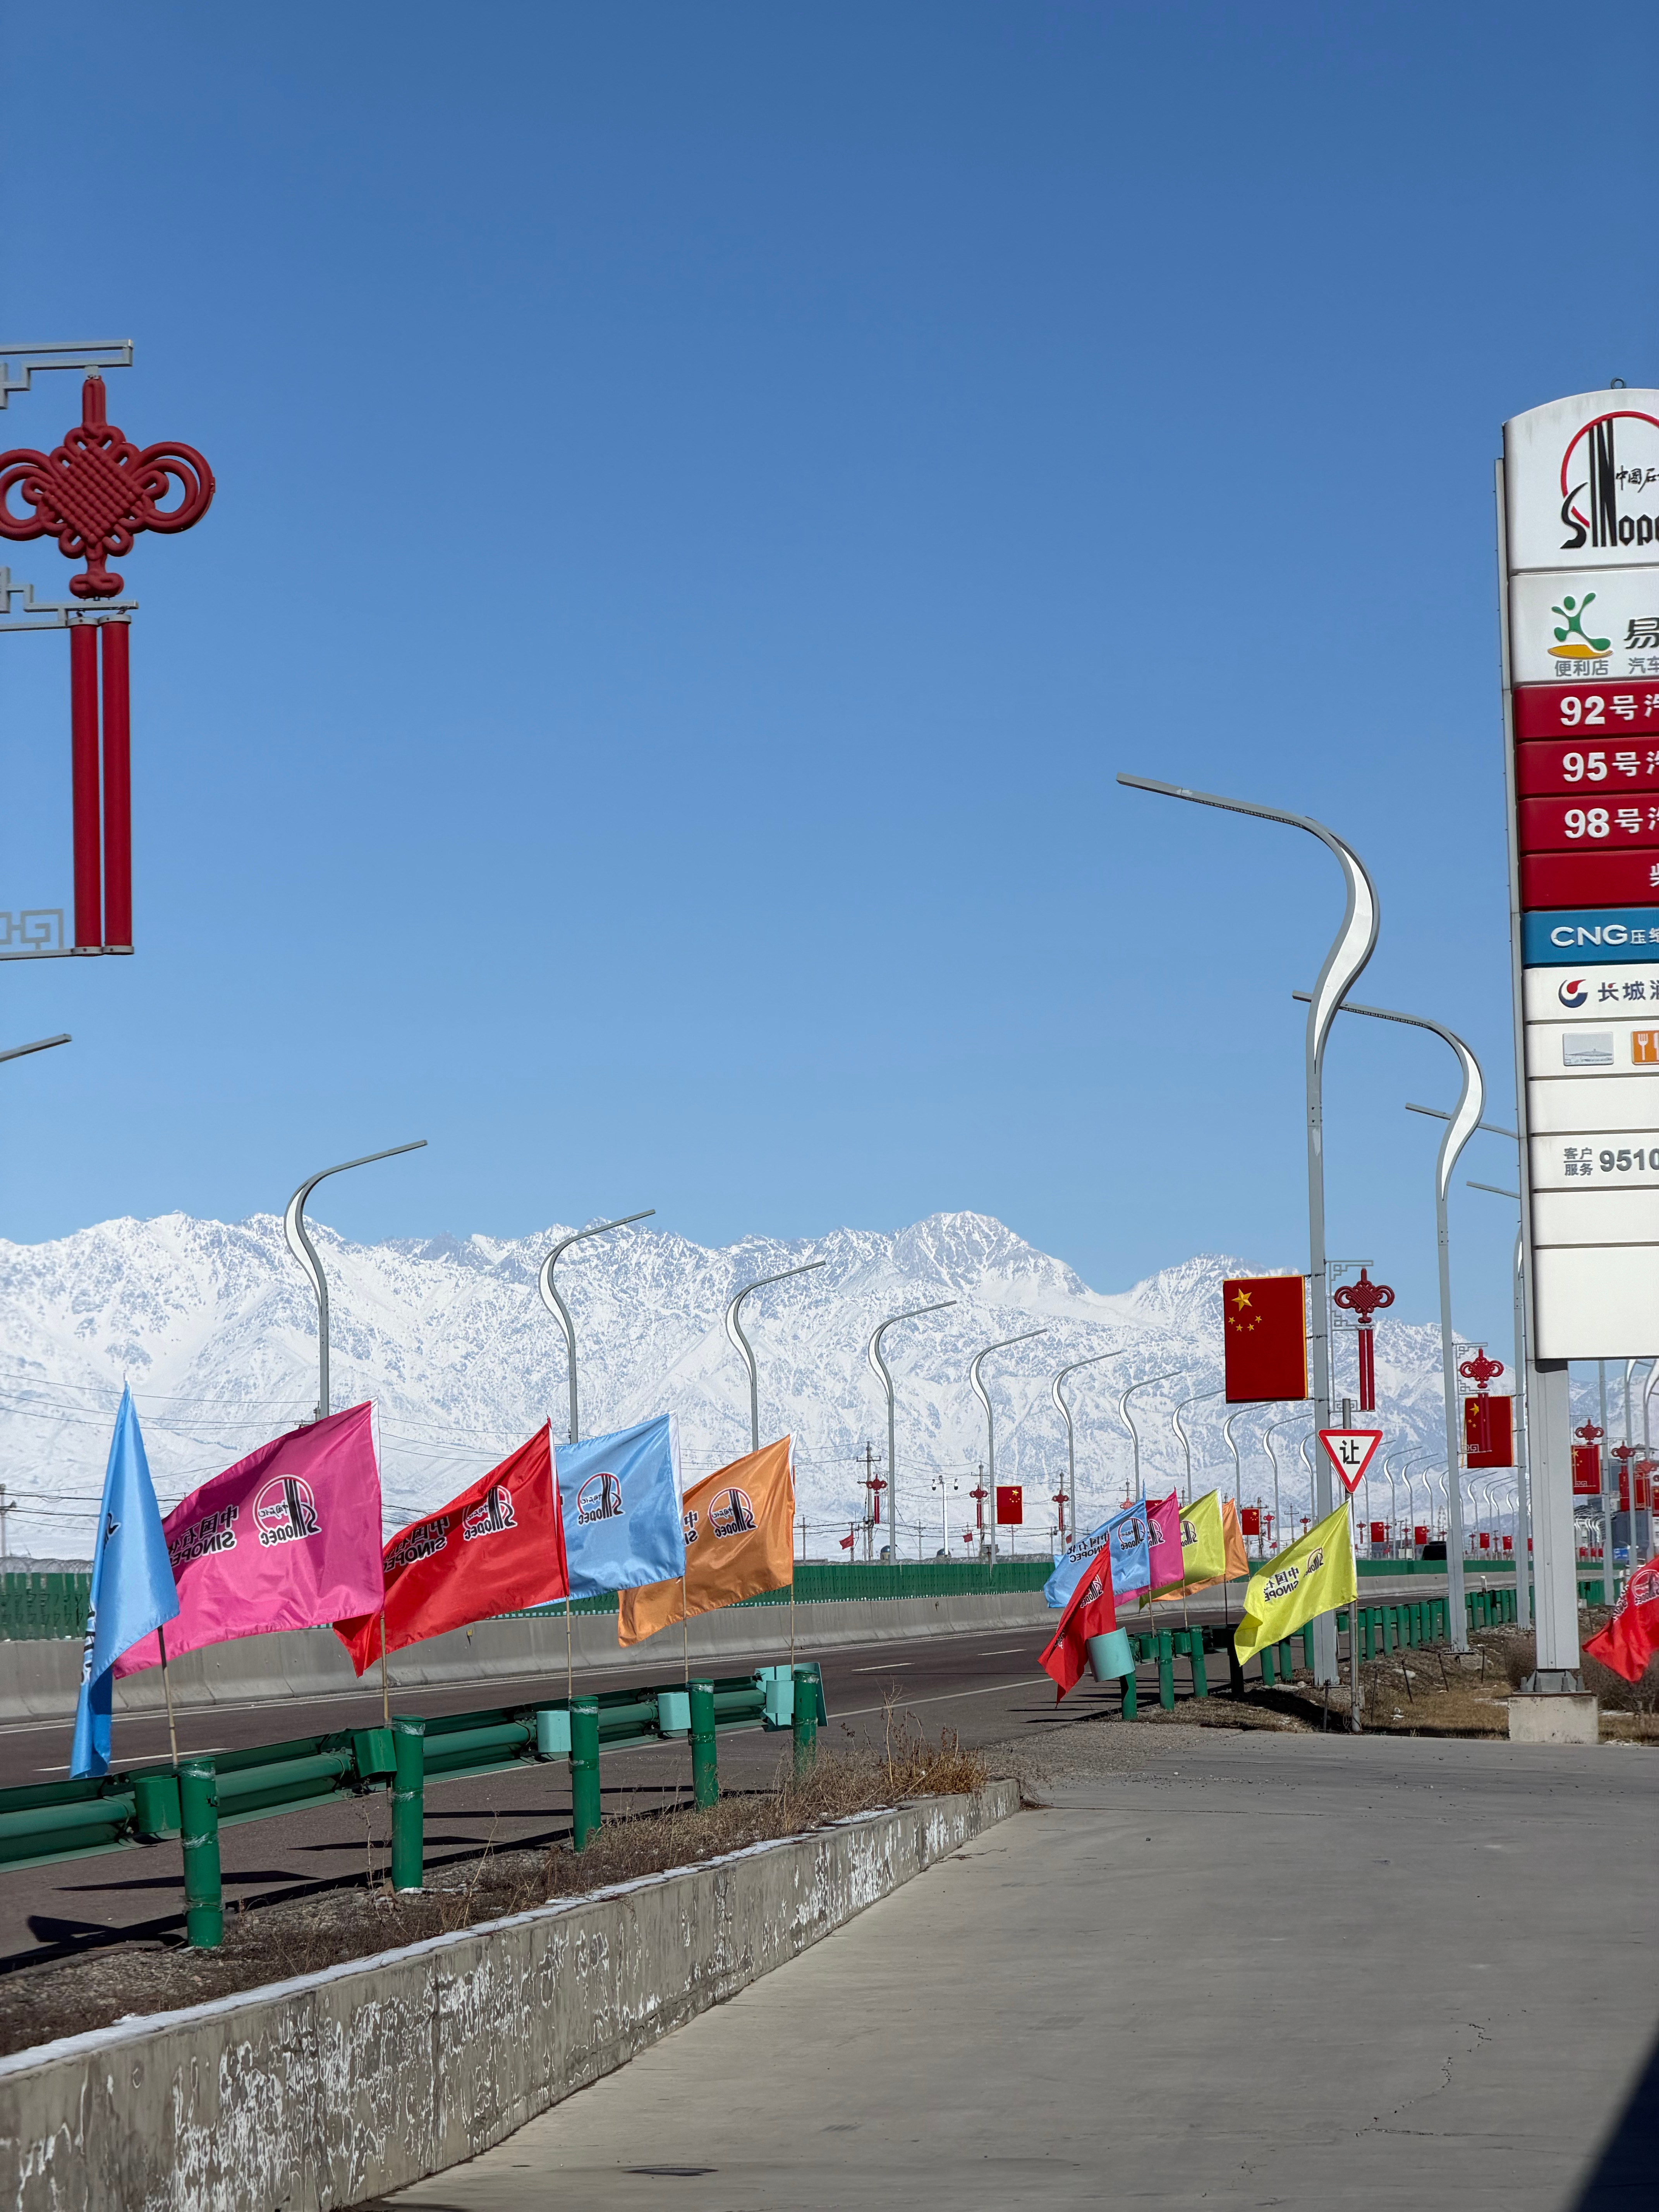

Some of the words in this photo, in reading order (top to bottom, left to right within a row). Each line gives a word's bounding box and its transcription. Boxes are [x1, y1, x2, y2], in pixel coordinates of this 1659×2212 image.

[1554, 659, 1608, 677] 便利店
[1563, 1147, 1592, 1160] 客户
[1600, 1149, 1659, 1172] 9510
[1564, 1163, 1593, 1176] 服务
[1340, 1439, 1360, 1465] 让
